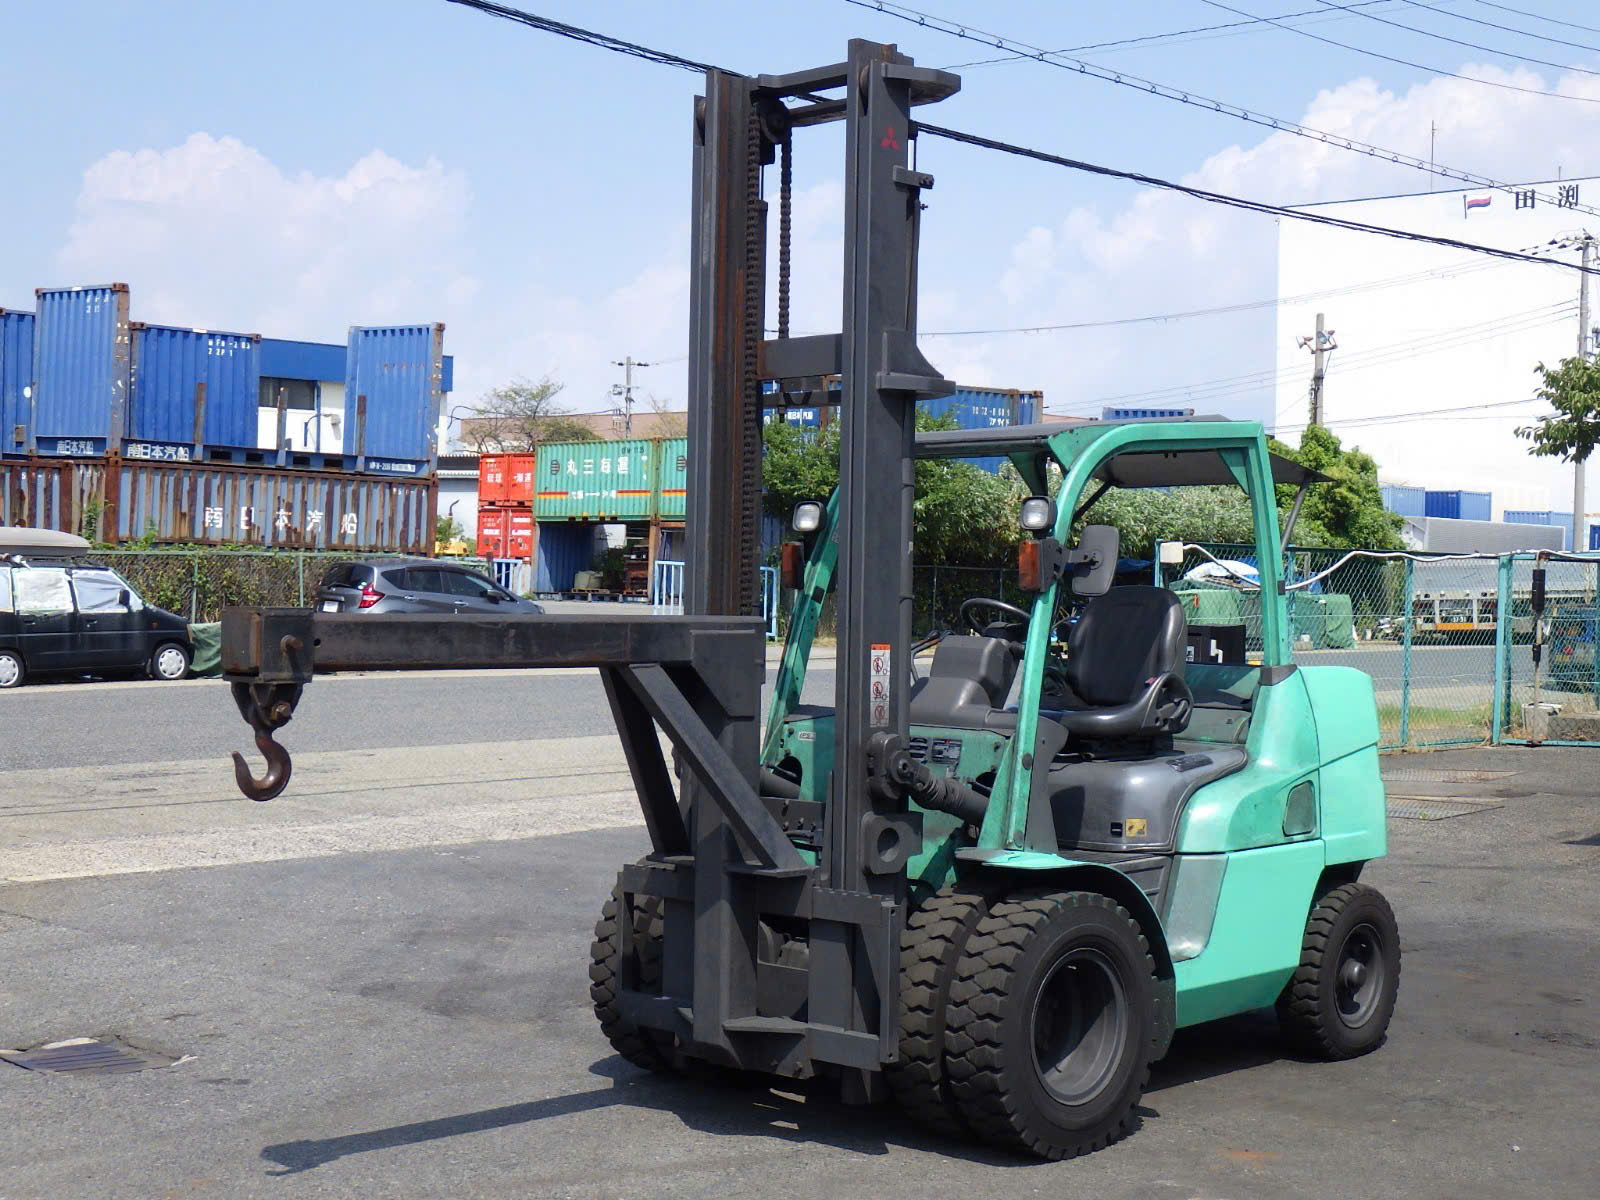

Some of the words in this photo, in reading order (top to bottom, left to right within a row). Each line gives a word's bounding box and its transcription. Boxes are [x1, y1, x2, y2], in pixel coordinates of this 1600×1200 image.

[57, 440, 94, 454] 南日本汽船
[127, 443, 190, 461] 南日本汽船
